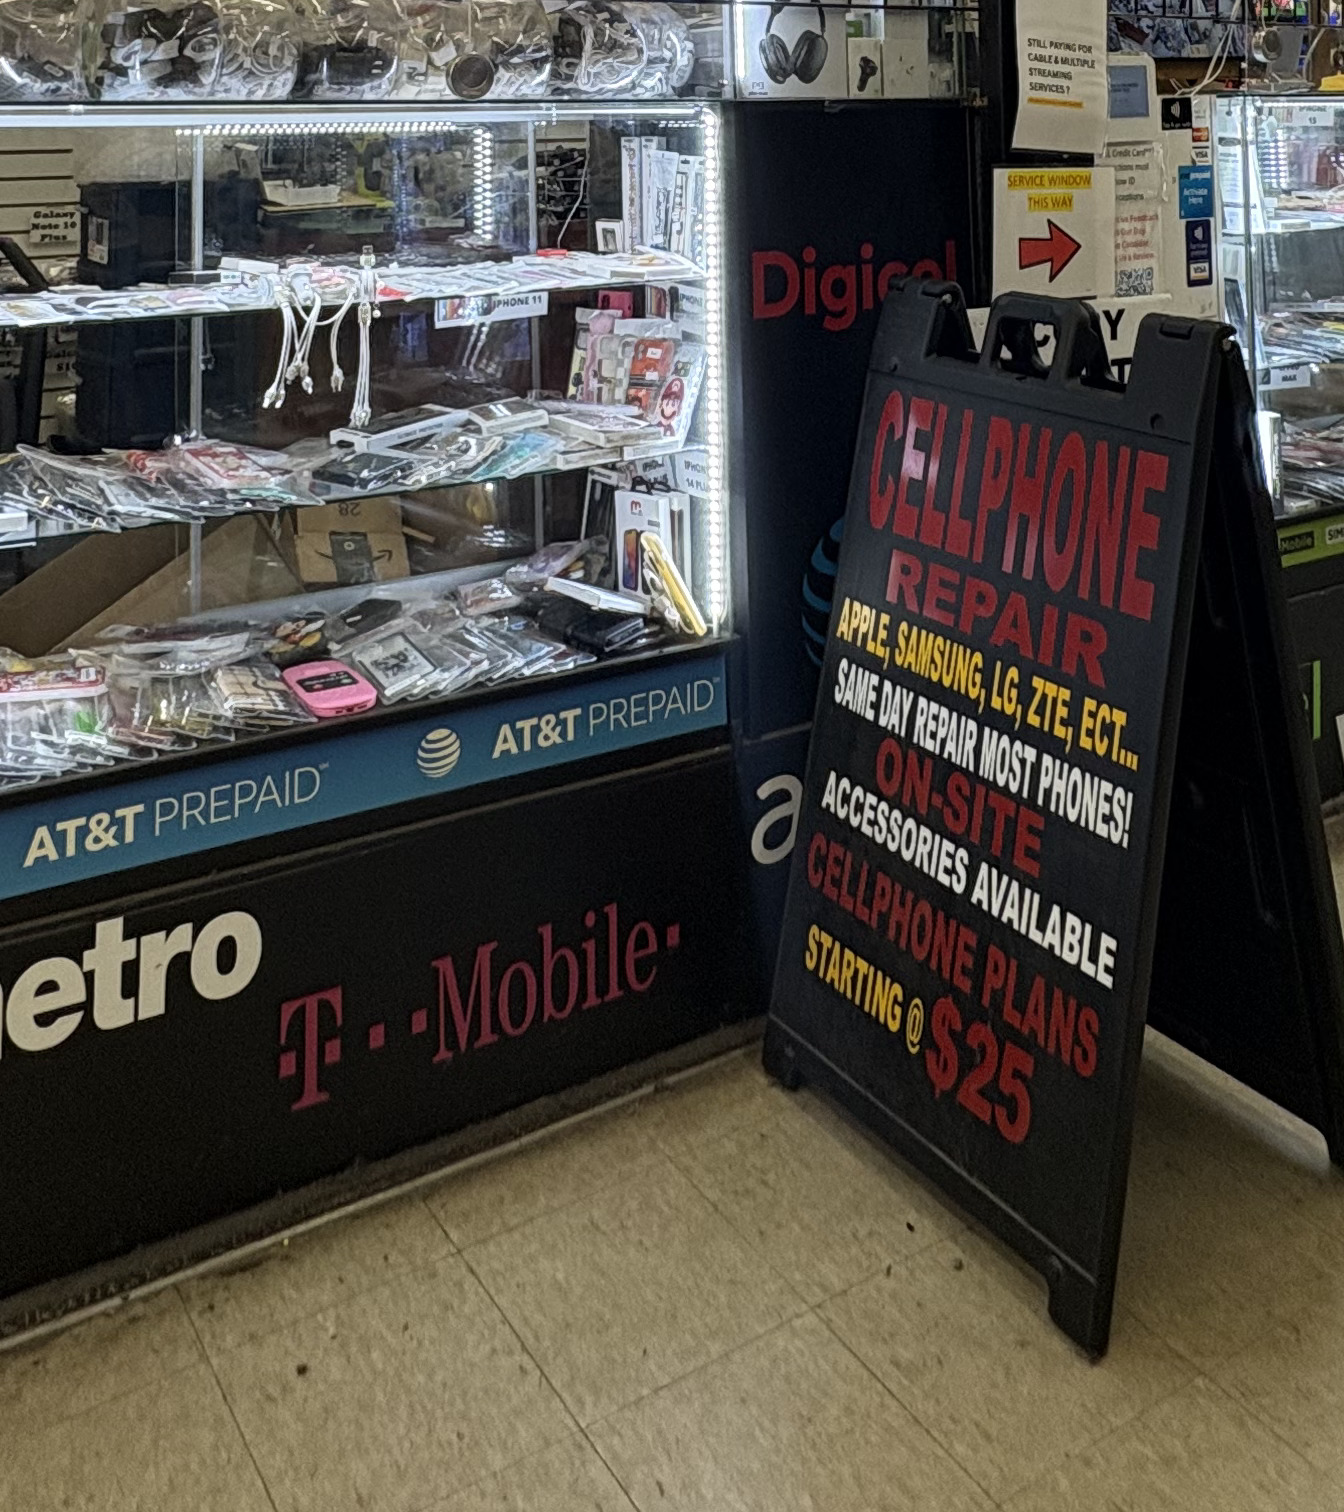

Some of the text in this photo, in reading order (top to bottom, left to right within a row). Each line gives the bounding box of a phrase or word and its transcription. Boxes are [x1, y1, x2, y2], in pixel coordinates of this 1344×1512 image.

[1027, 37, 1094, 55] STILL PAYING FOR
[1027, 52, 1097, 70] CABLE MULTIPLE
[1028, 67, 1074, 82] STREAMING
[32, 209, 76, 220] Galaxy
[1007, 172, 1092, 188] SERVICE WINDOW
[1027, 195, 1074, 210] THIS WAY
[867, 388, 1170, 622] CELLPHONE
[836, 597, 1074, 753] APPLE, SAMSUNG, LG, ZTE,
[885, 548, 1108, 689] REPAIR
[490, 676, 716, 762] AT&T PREPAID
[834, 657, 1134, 850] SAME DAY REPAIR MOST PHONES!
[21, 763, 323, 870] AT&T PREPAID
[875, 737, 1046, 880] ON-SITE
[821, 769, 970, 895] ACCESSORIES
[971, 860, 1119, 991] AVAILABLE
[806, 831, 1102, 1080] CELLPHONE PLANS
[805, 924, 904, 1034] STARTING
[924, 993, 1036, 1146] $25
